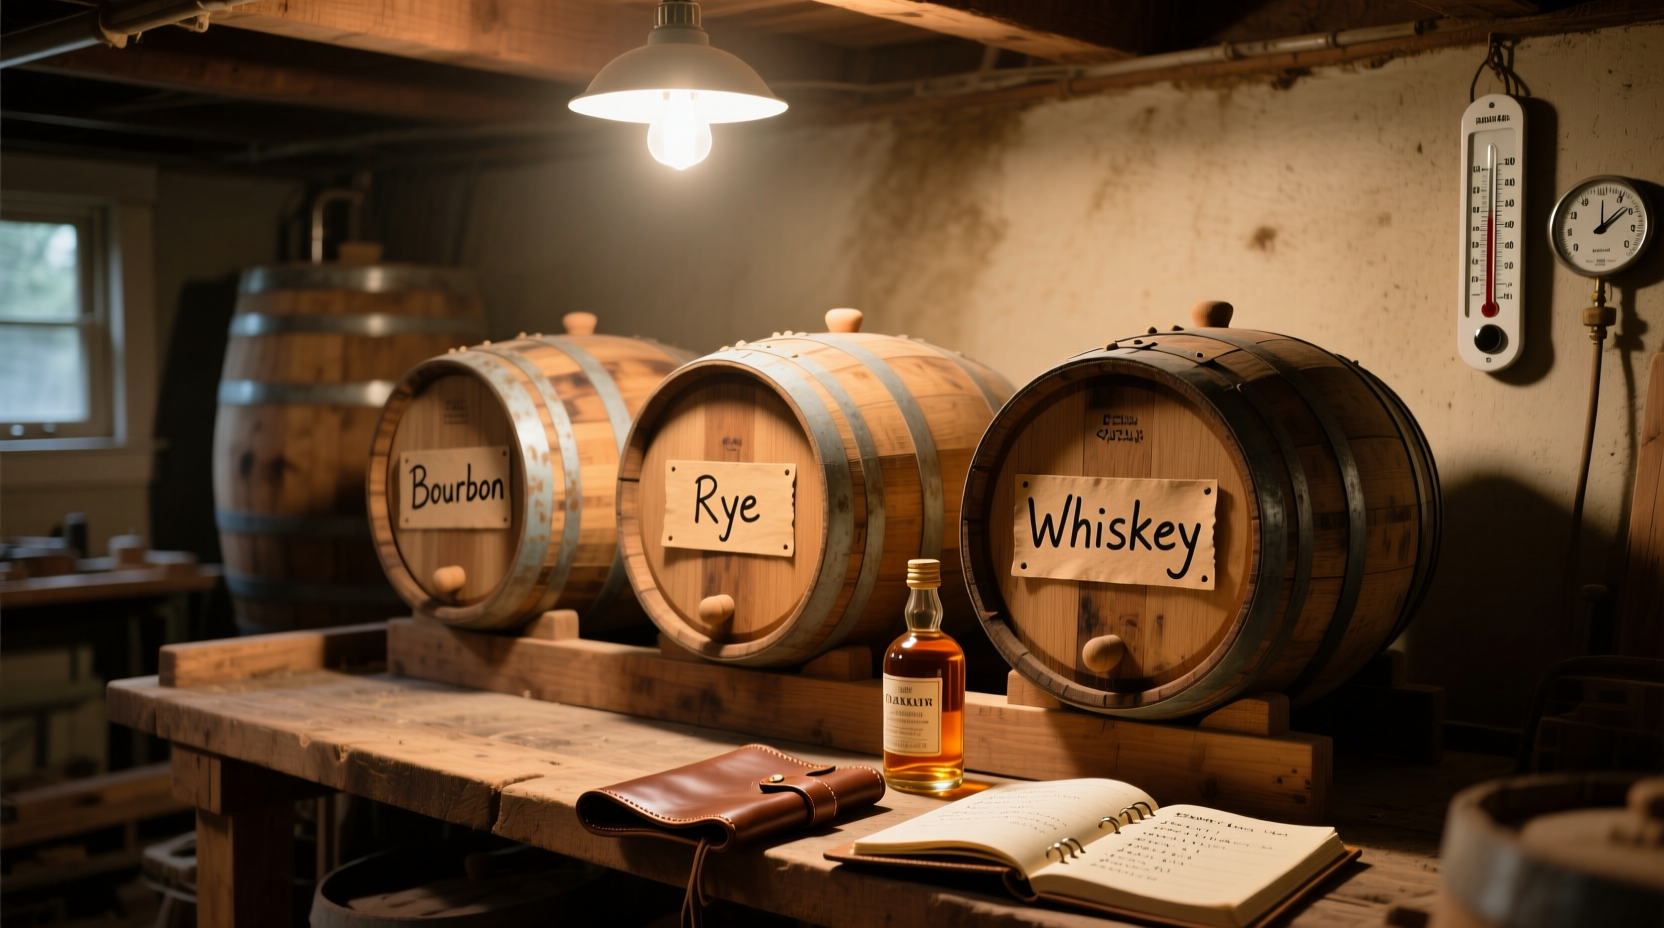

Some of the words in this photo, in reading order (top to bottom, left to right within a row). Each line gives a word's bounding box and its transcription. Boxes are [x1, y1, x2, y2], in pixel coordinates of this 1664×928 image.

[409, 463, 504, 510] Bourbon
[694, 474, 760, 542] Rye
[1028, 494, 1201, 579] Whiskey
